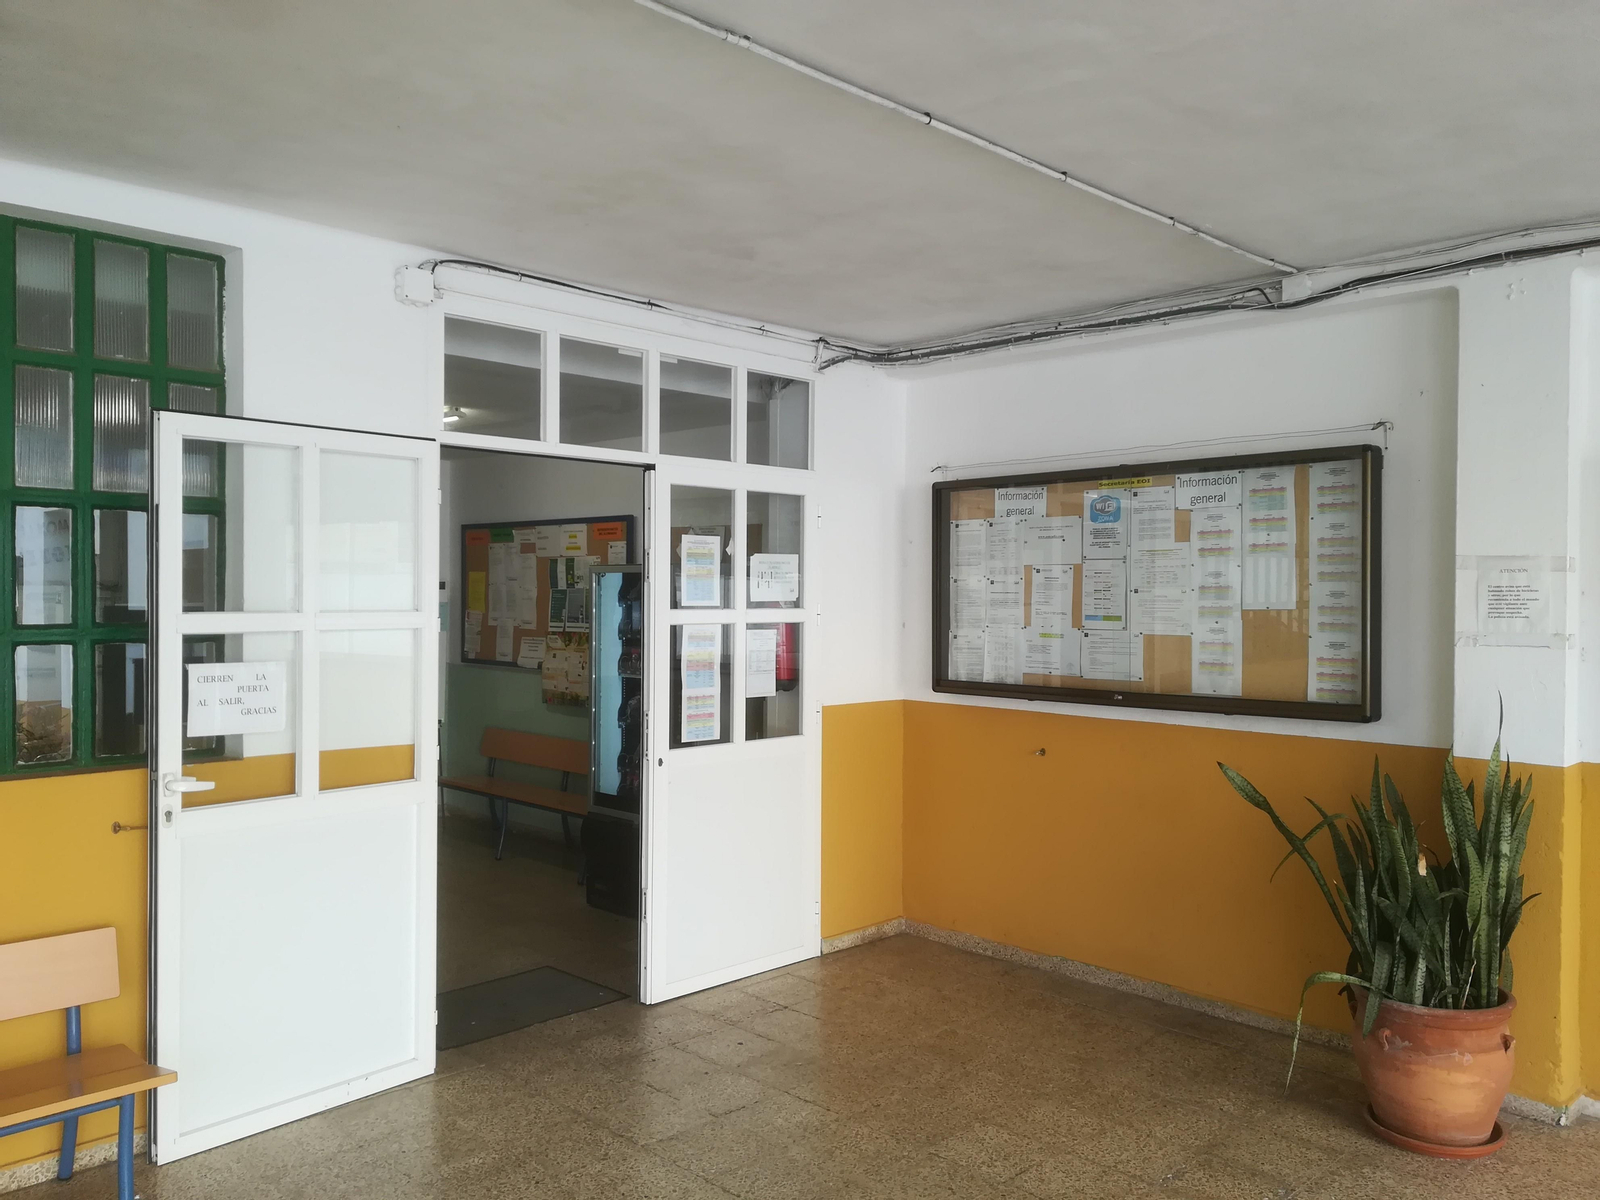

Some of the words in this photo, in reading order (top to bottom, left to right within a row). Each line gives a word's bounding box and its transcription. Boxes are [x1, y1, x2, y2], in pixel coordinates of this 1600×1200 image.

[1179, 474, 1238, 488] Información
[998, 490, 1044, 500] Información
[1190, 492, 1226, 506] general
[1006, 506, 1034, 517] general
[197, 675, 234, 683] CIERREN
[237, 685, 269, 693] PUERTA
[219, 697, 245, 706] SALIR,
[240, 706, 277, 716] GRACIAS
